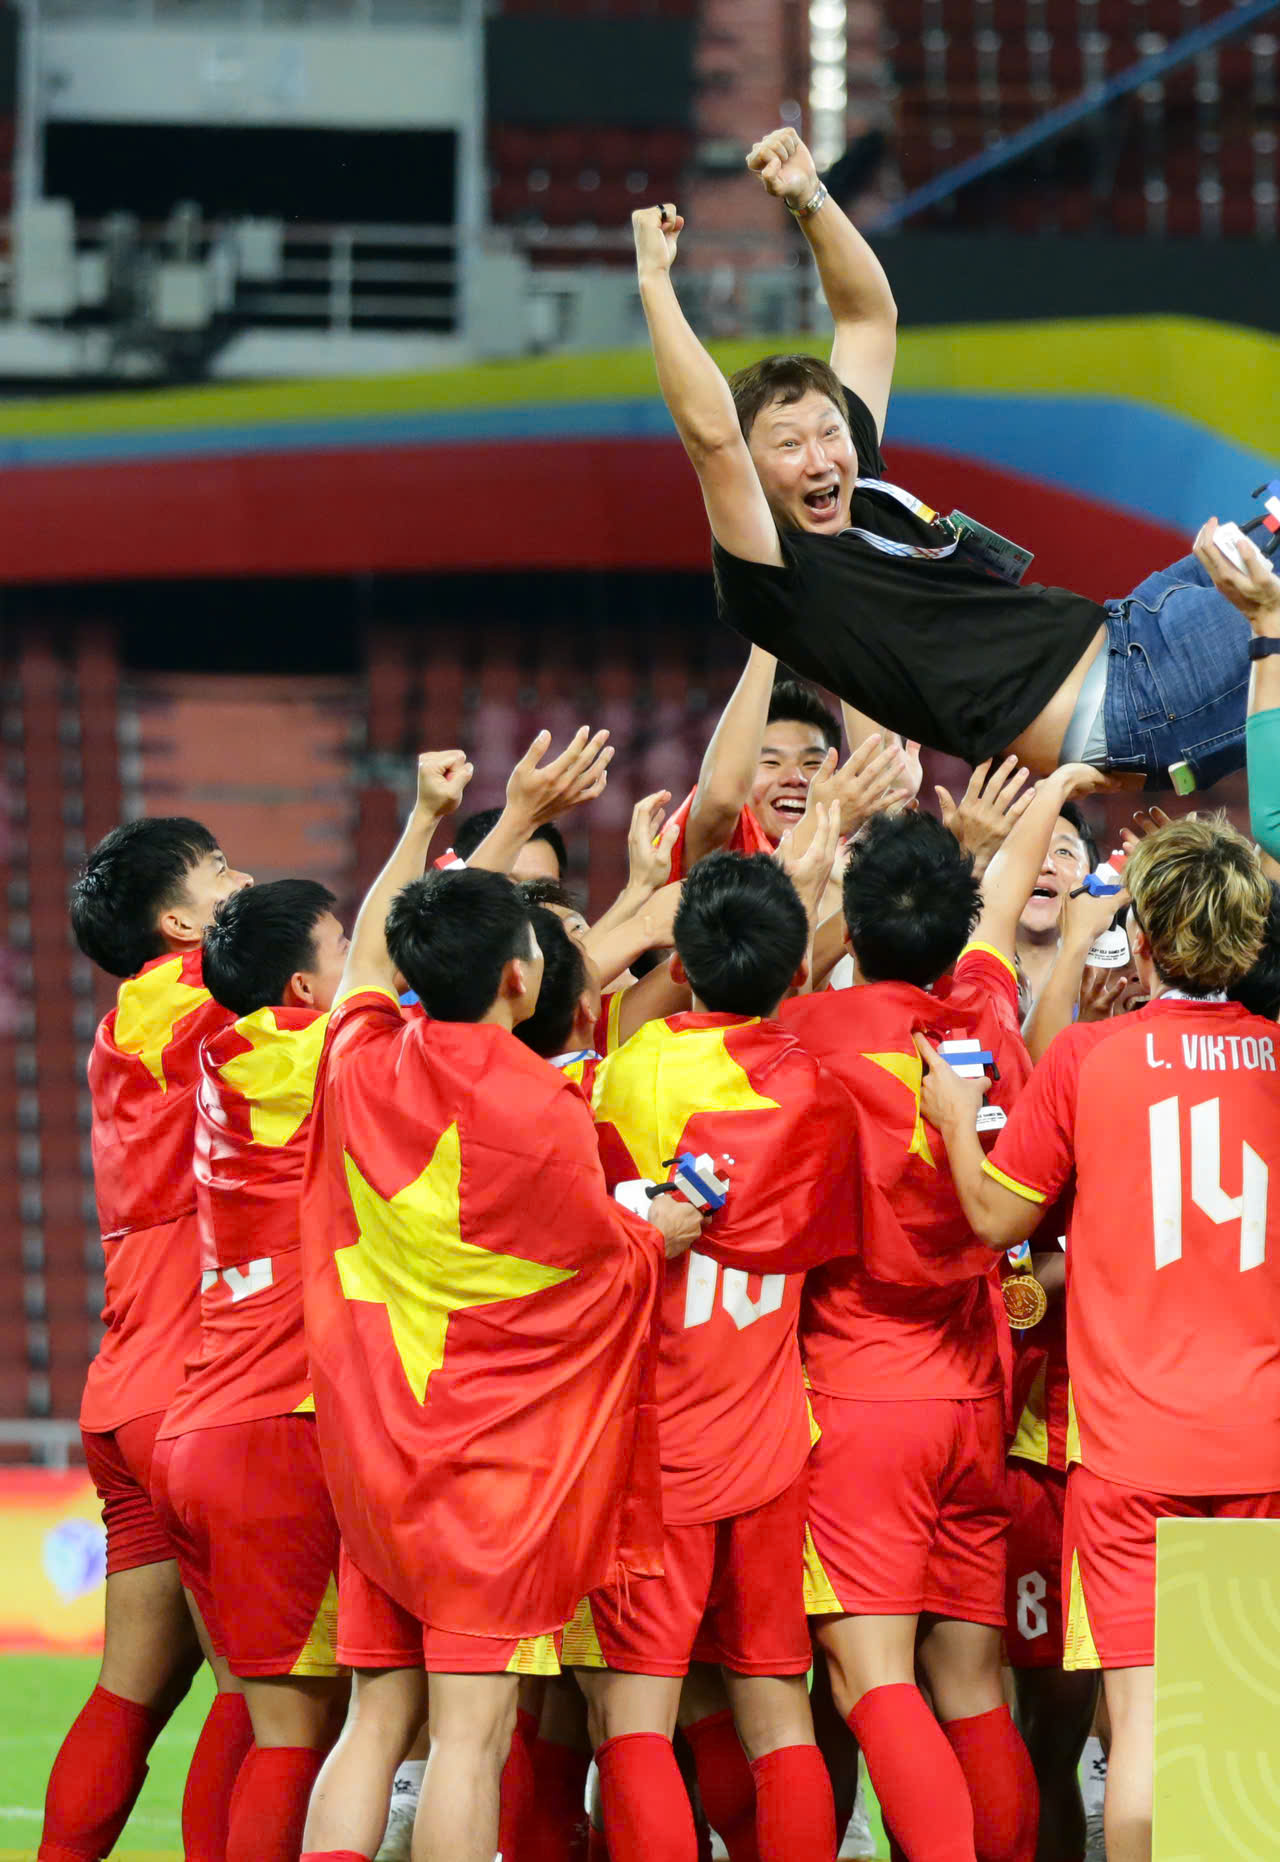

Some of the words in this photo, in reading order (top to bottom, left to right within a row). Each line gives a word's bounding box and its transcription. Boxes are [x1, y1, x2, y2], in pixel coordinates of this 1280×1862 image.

[1146, 1032, 1172, 1069] L.
[1181, 1033, 1277, 1072] VIKTOR
[1148, 1095, 1269, 1273] 14
[1016, 1569, 1049, 1641] 8
